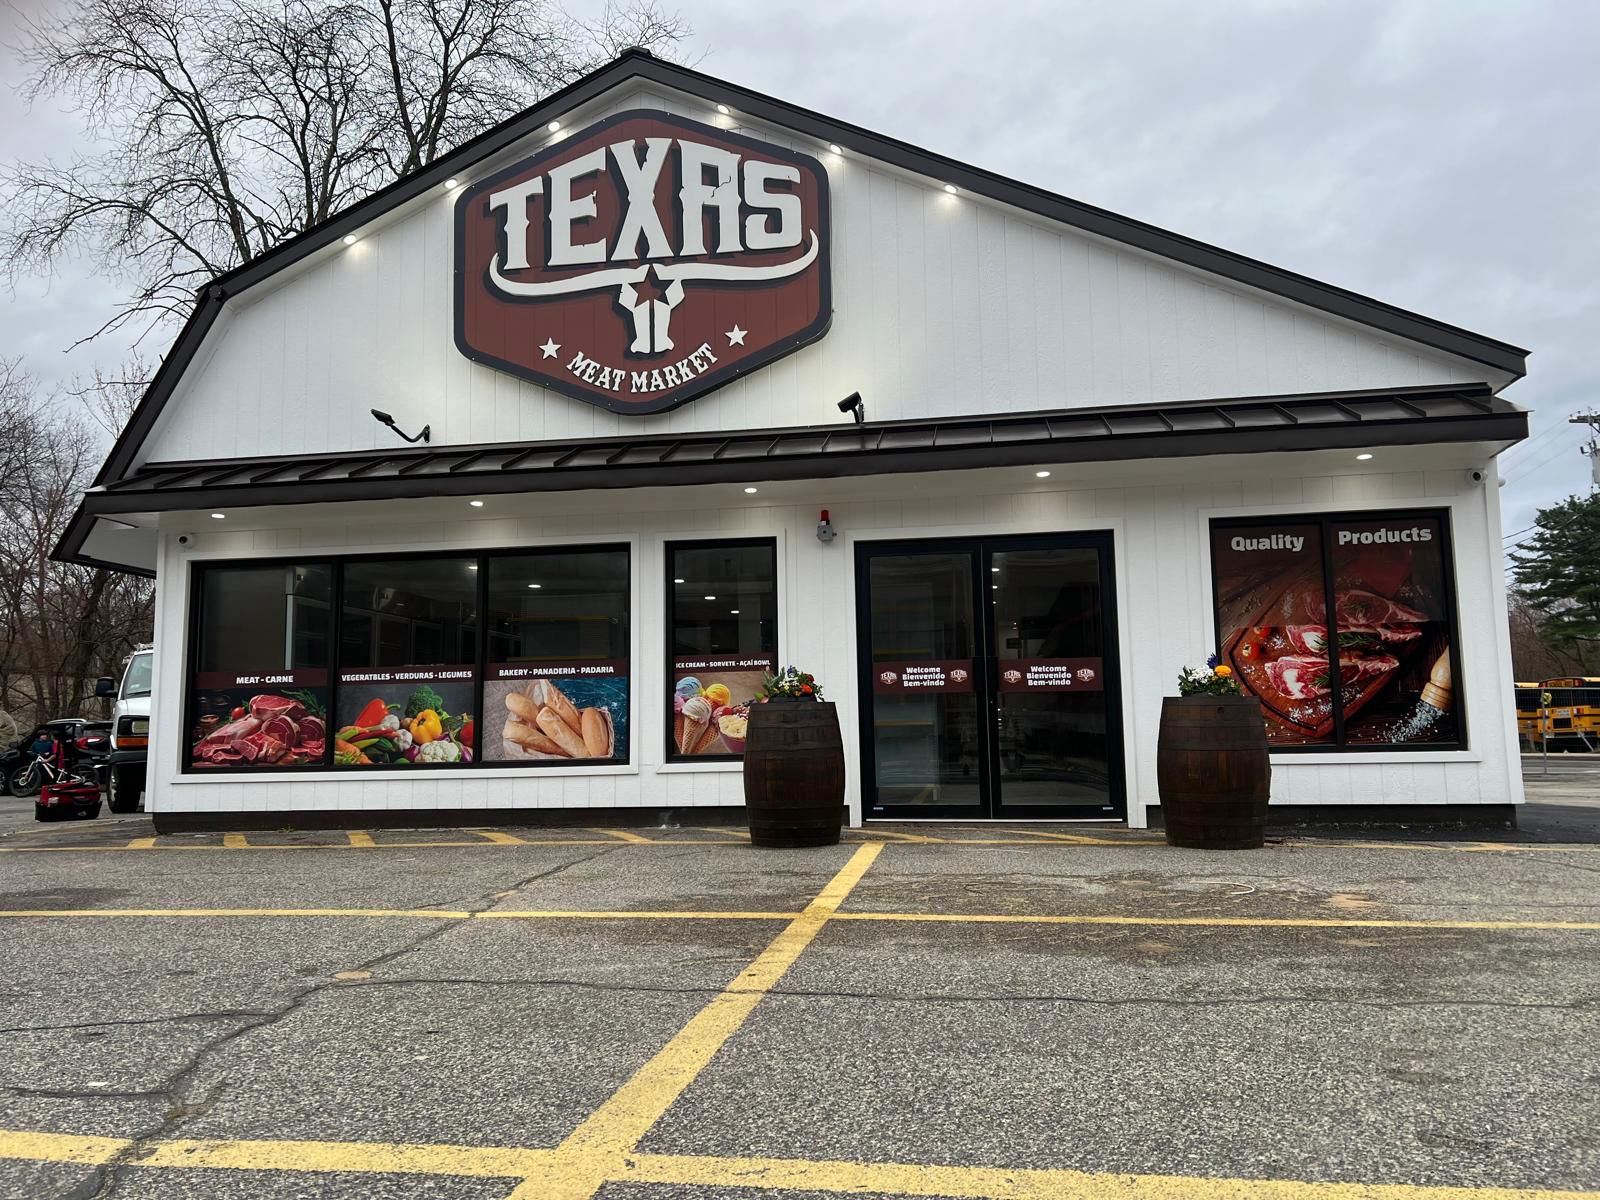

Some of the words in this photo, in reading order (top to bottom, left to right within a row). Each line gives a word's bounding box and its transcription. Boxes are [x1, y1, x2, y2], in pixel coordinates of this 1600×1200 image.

[490, 138, 803, 270] TEXAS
[566, 351, 626, 392] MEAT
[630, 342, 719, 393] MARKET
[1231, 534, 1305, 552] Quality
[1338, 527, 1432, 545] Products
[709, 660, 736, 668] SORVETE
[1030, 665, 1067, 673] Welcome
[499, 669, 528, 677] BAKERY
[533, 667, 576, 676] PANADERIA
[581, 666, 614, 674] PADARIA
[906, 666, 941, 674] Welcome
[236, 676, 260, 685] MEAT
[265, 675, 294, 684] CARNE
[341, 673, 390, 682] VEGERATBLES
[395, 672, 434, 680] VERDURAS
[438, 671, 472, 679] LEGUMES
[902, 673, 946, 681] Bienvenido
[1026, 672, 1072, 680] Bienvenido
